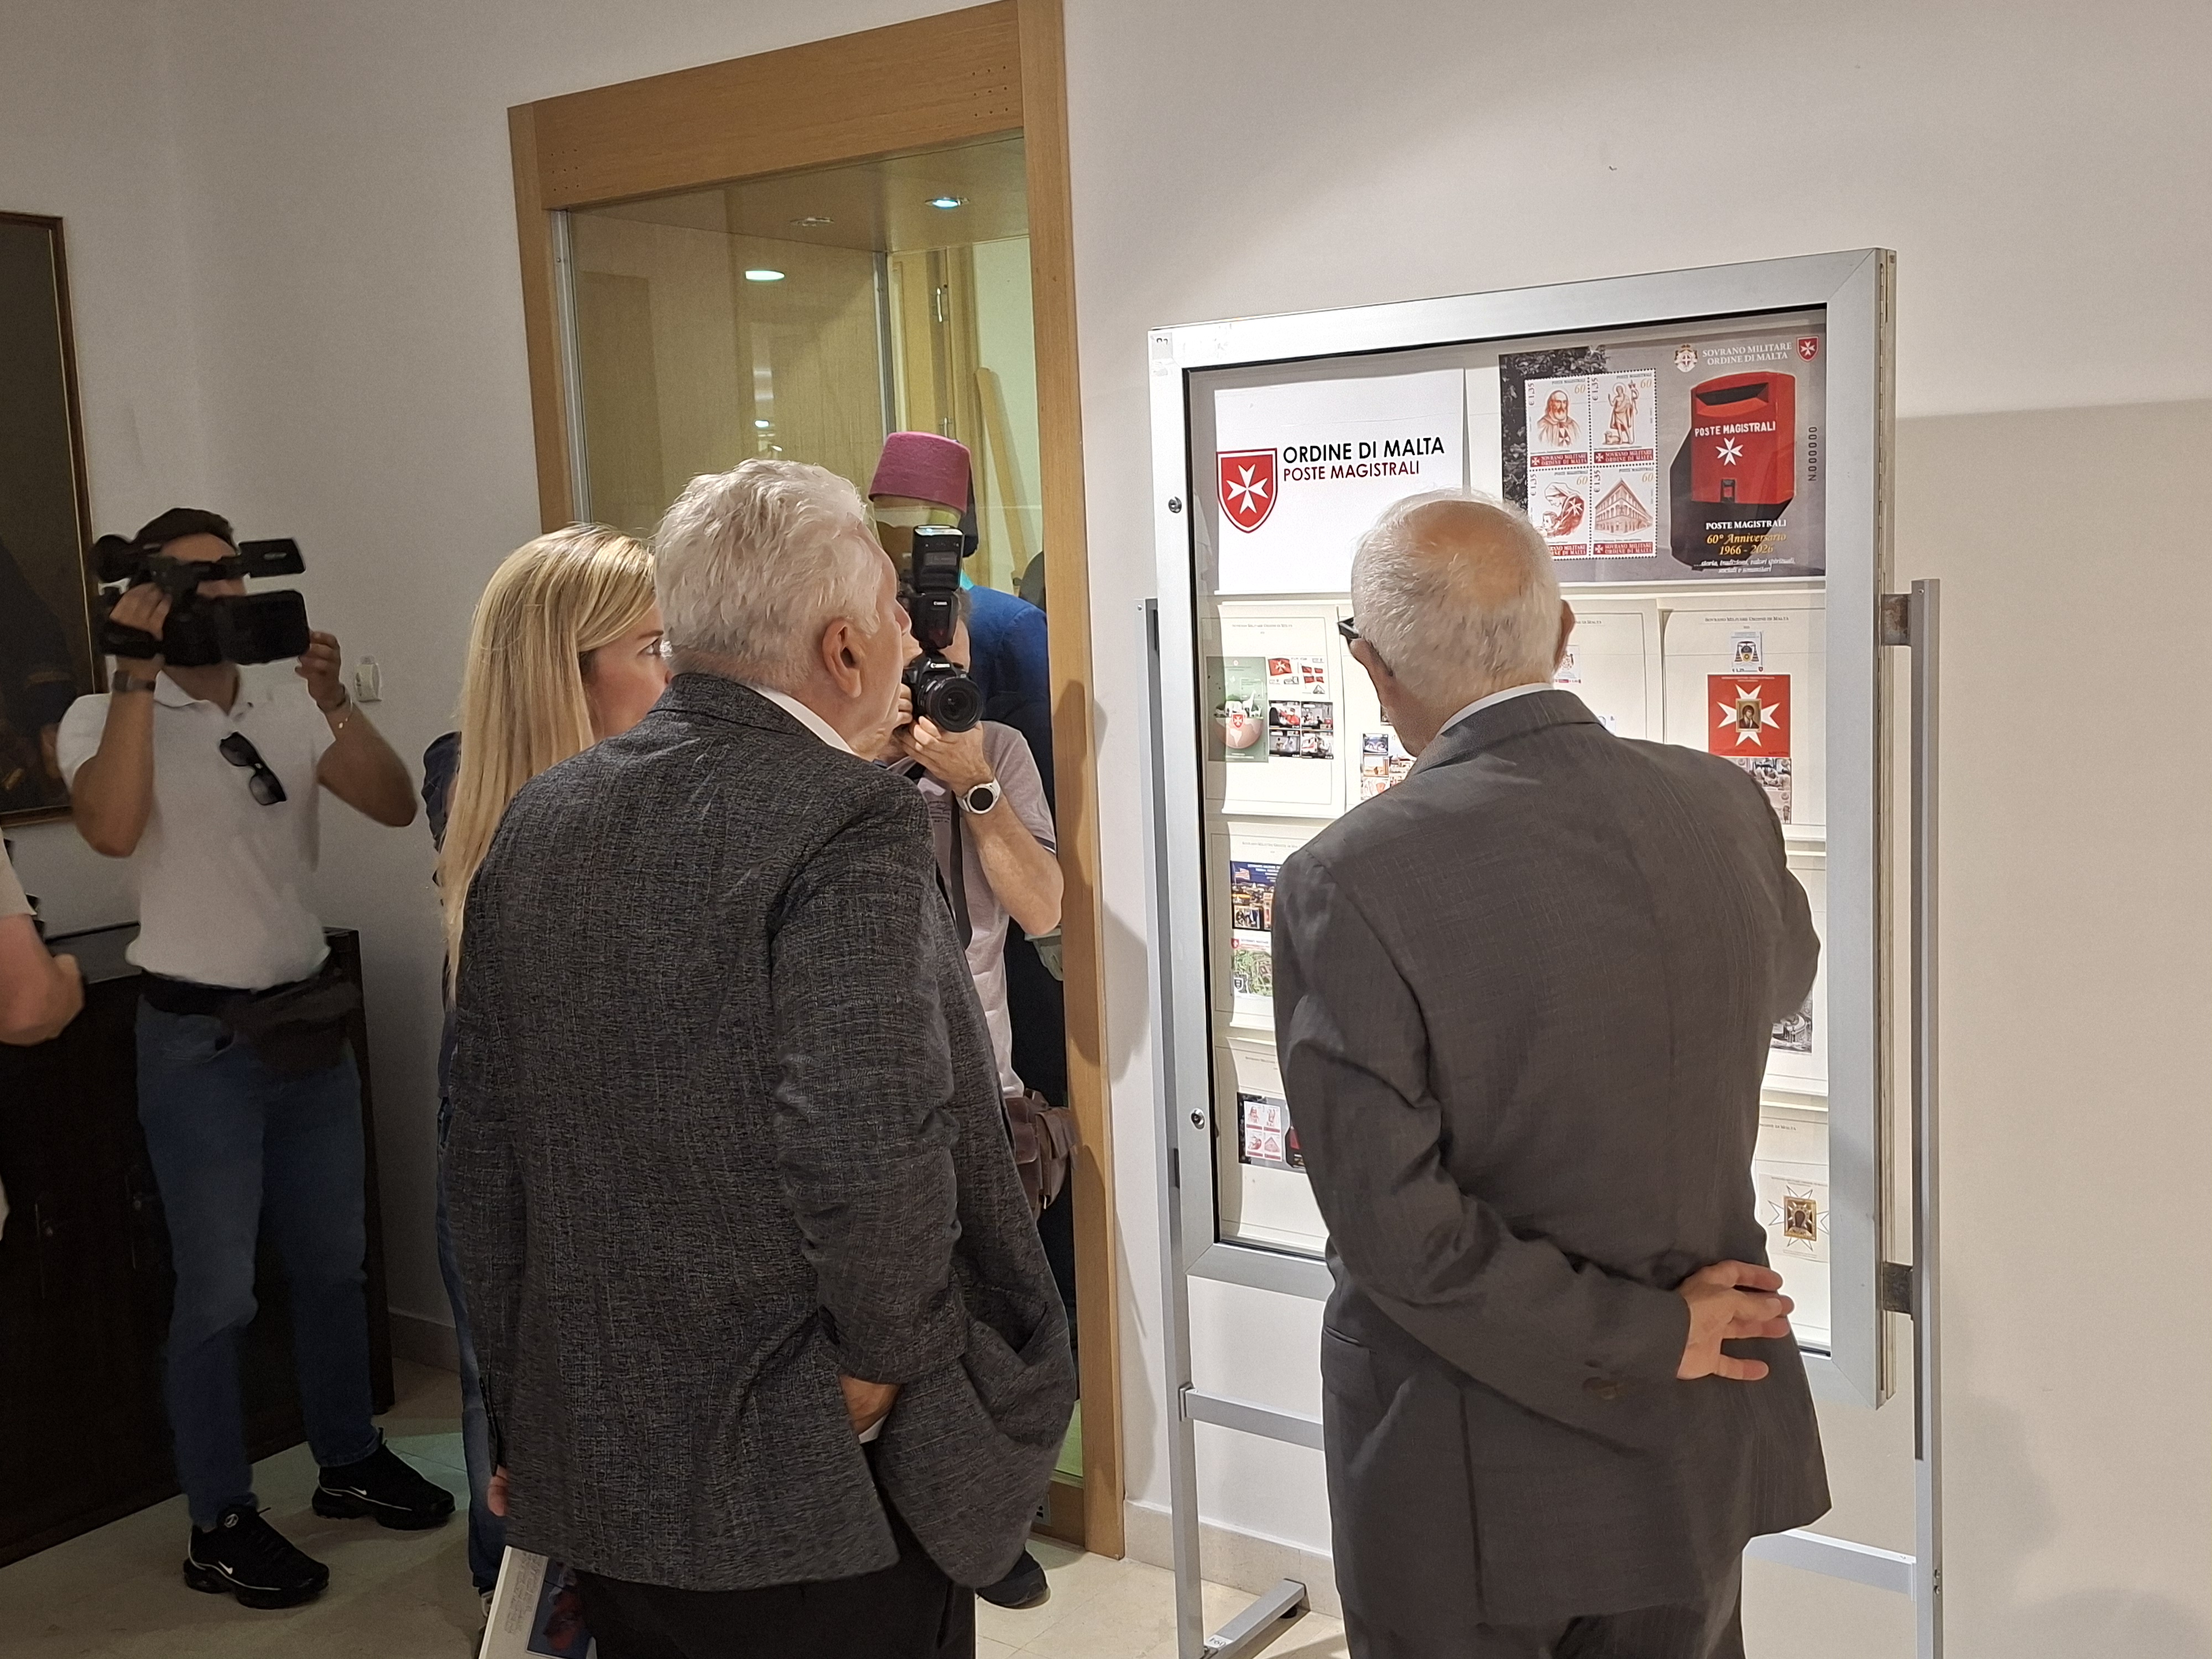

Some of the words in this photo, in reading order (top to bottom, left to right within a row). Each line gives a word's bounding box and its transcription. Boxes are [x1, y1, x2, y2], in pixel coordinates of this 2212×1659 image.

[1702, 346, 1746, 357] SOVRANO
[1747, 342, 1792, 354] MILITARE
[1707, 355, 1743, 366] ORDINE
[1744, 354, 1755, 362] DI
[1756, 352, 1788, 361] MALTA
[1574, 383, 1586, 394] 60
[1640, 378, 1652, 388] 60
[1694, 425, 1721, 437] POSTE
[1723, 421, 1776, 434] MAGISTRALI
[1283, 444, 1352, 463] ORDINE
[1359, 441, 1376, 459] DI
[1384, 437, 1444, 457] MALTA
[1284, 466, 1326, 481] POSTE
[1331, 461, 1420, 479] MAGISTRALI
[1576, 476, 1588, 486] 60
[1641, 473, 1653, 483] 60
[1705, 521, 1733, 530] POSTE
[1734, 519, 1786, 529] MAGISTRALI
[1724, 533, 1786, 545] Anniversario
[1719, 545, 1741, 555] 1966
[1750, 544, 1773, 555] 2026
